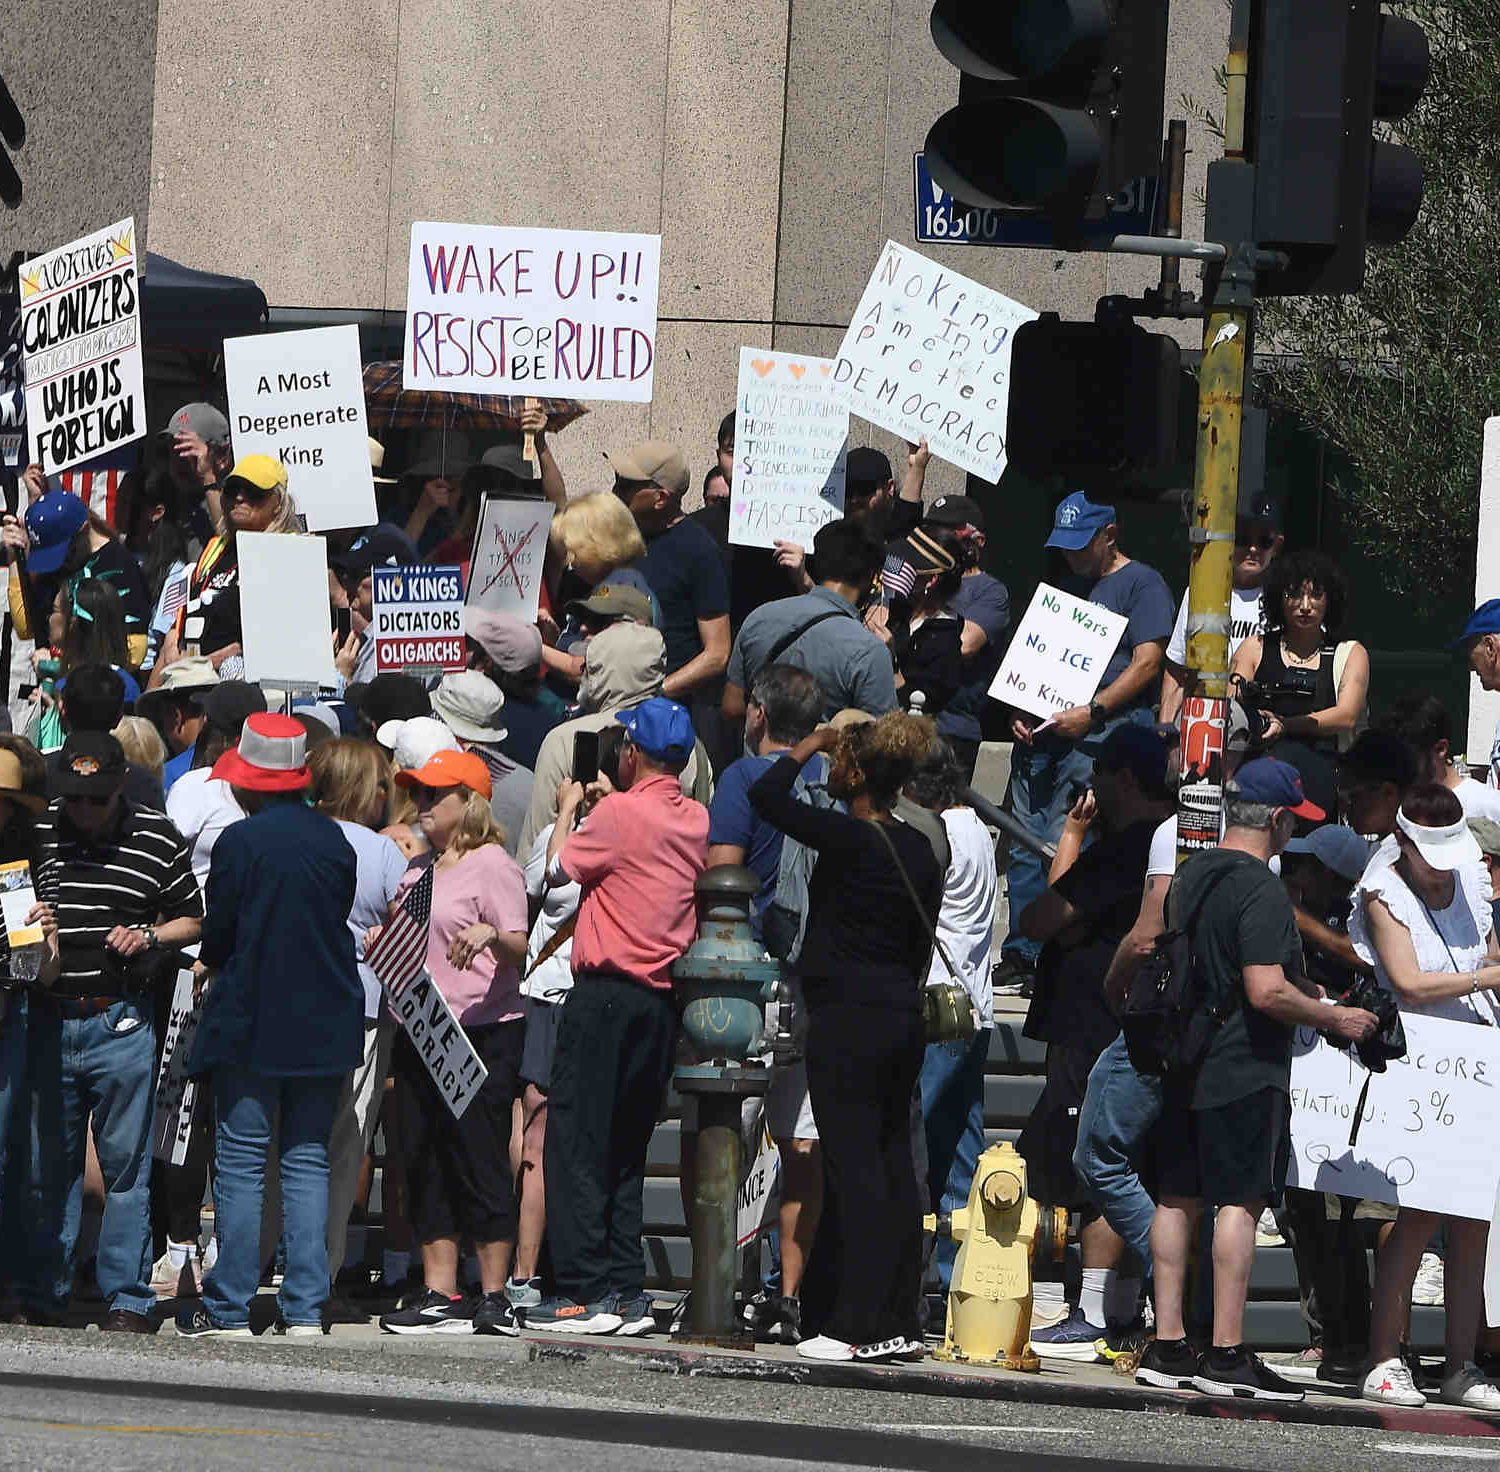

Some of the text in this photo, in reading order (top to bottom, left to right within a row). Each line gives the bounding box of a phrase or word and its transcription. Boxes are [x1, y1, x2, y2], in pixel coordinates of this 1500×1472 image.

[423, 243, 642, 303] WAKE UP!!
[23, 268, 135, 354] COLONIZERS
[412, 311, 652, 381] RESIST OR BE RULED
[856, 325, 997, 411] Protec
[865, 301, 1005, 385] Americ
[43, 367, 99, 423] WHO
[101, 358, 122, 401] IS
[257, 370, 331, 396] A Most
[834, 358, 1007, 460] DEMOCRACY
[37, 395, 135, 471] FOREIGN
[238, 405, 357, 437] Degenerate
[278, 446, 324, 467] King
[748, 501, 832, 529] FASCISM
[378, 575, 459, 602] NO KINGS
[1041, 592, 1109, 637] No Wars
[379, 610, 461, 633] DICTATORS
[381, 641, 461, 665] OLIGARCHS
[1026, 631, 1093, 672] No ICE
[1006, 670, 1027, 692] No
[412, 980, 459, 1053] AVE
[402, 1000, 465, 1104] OCRACY
